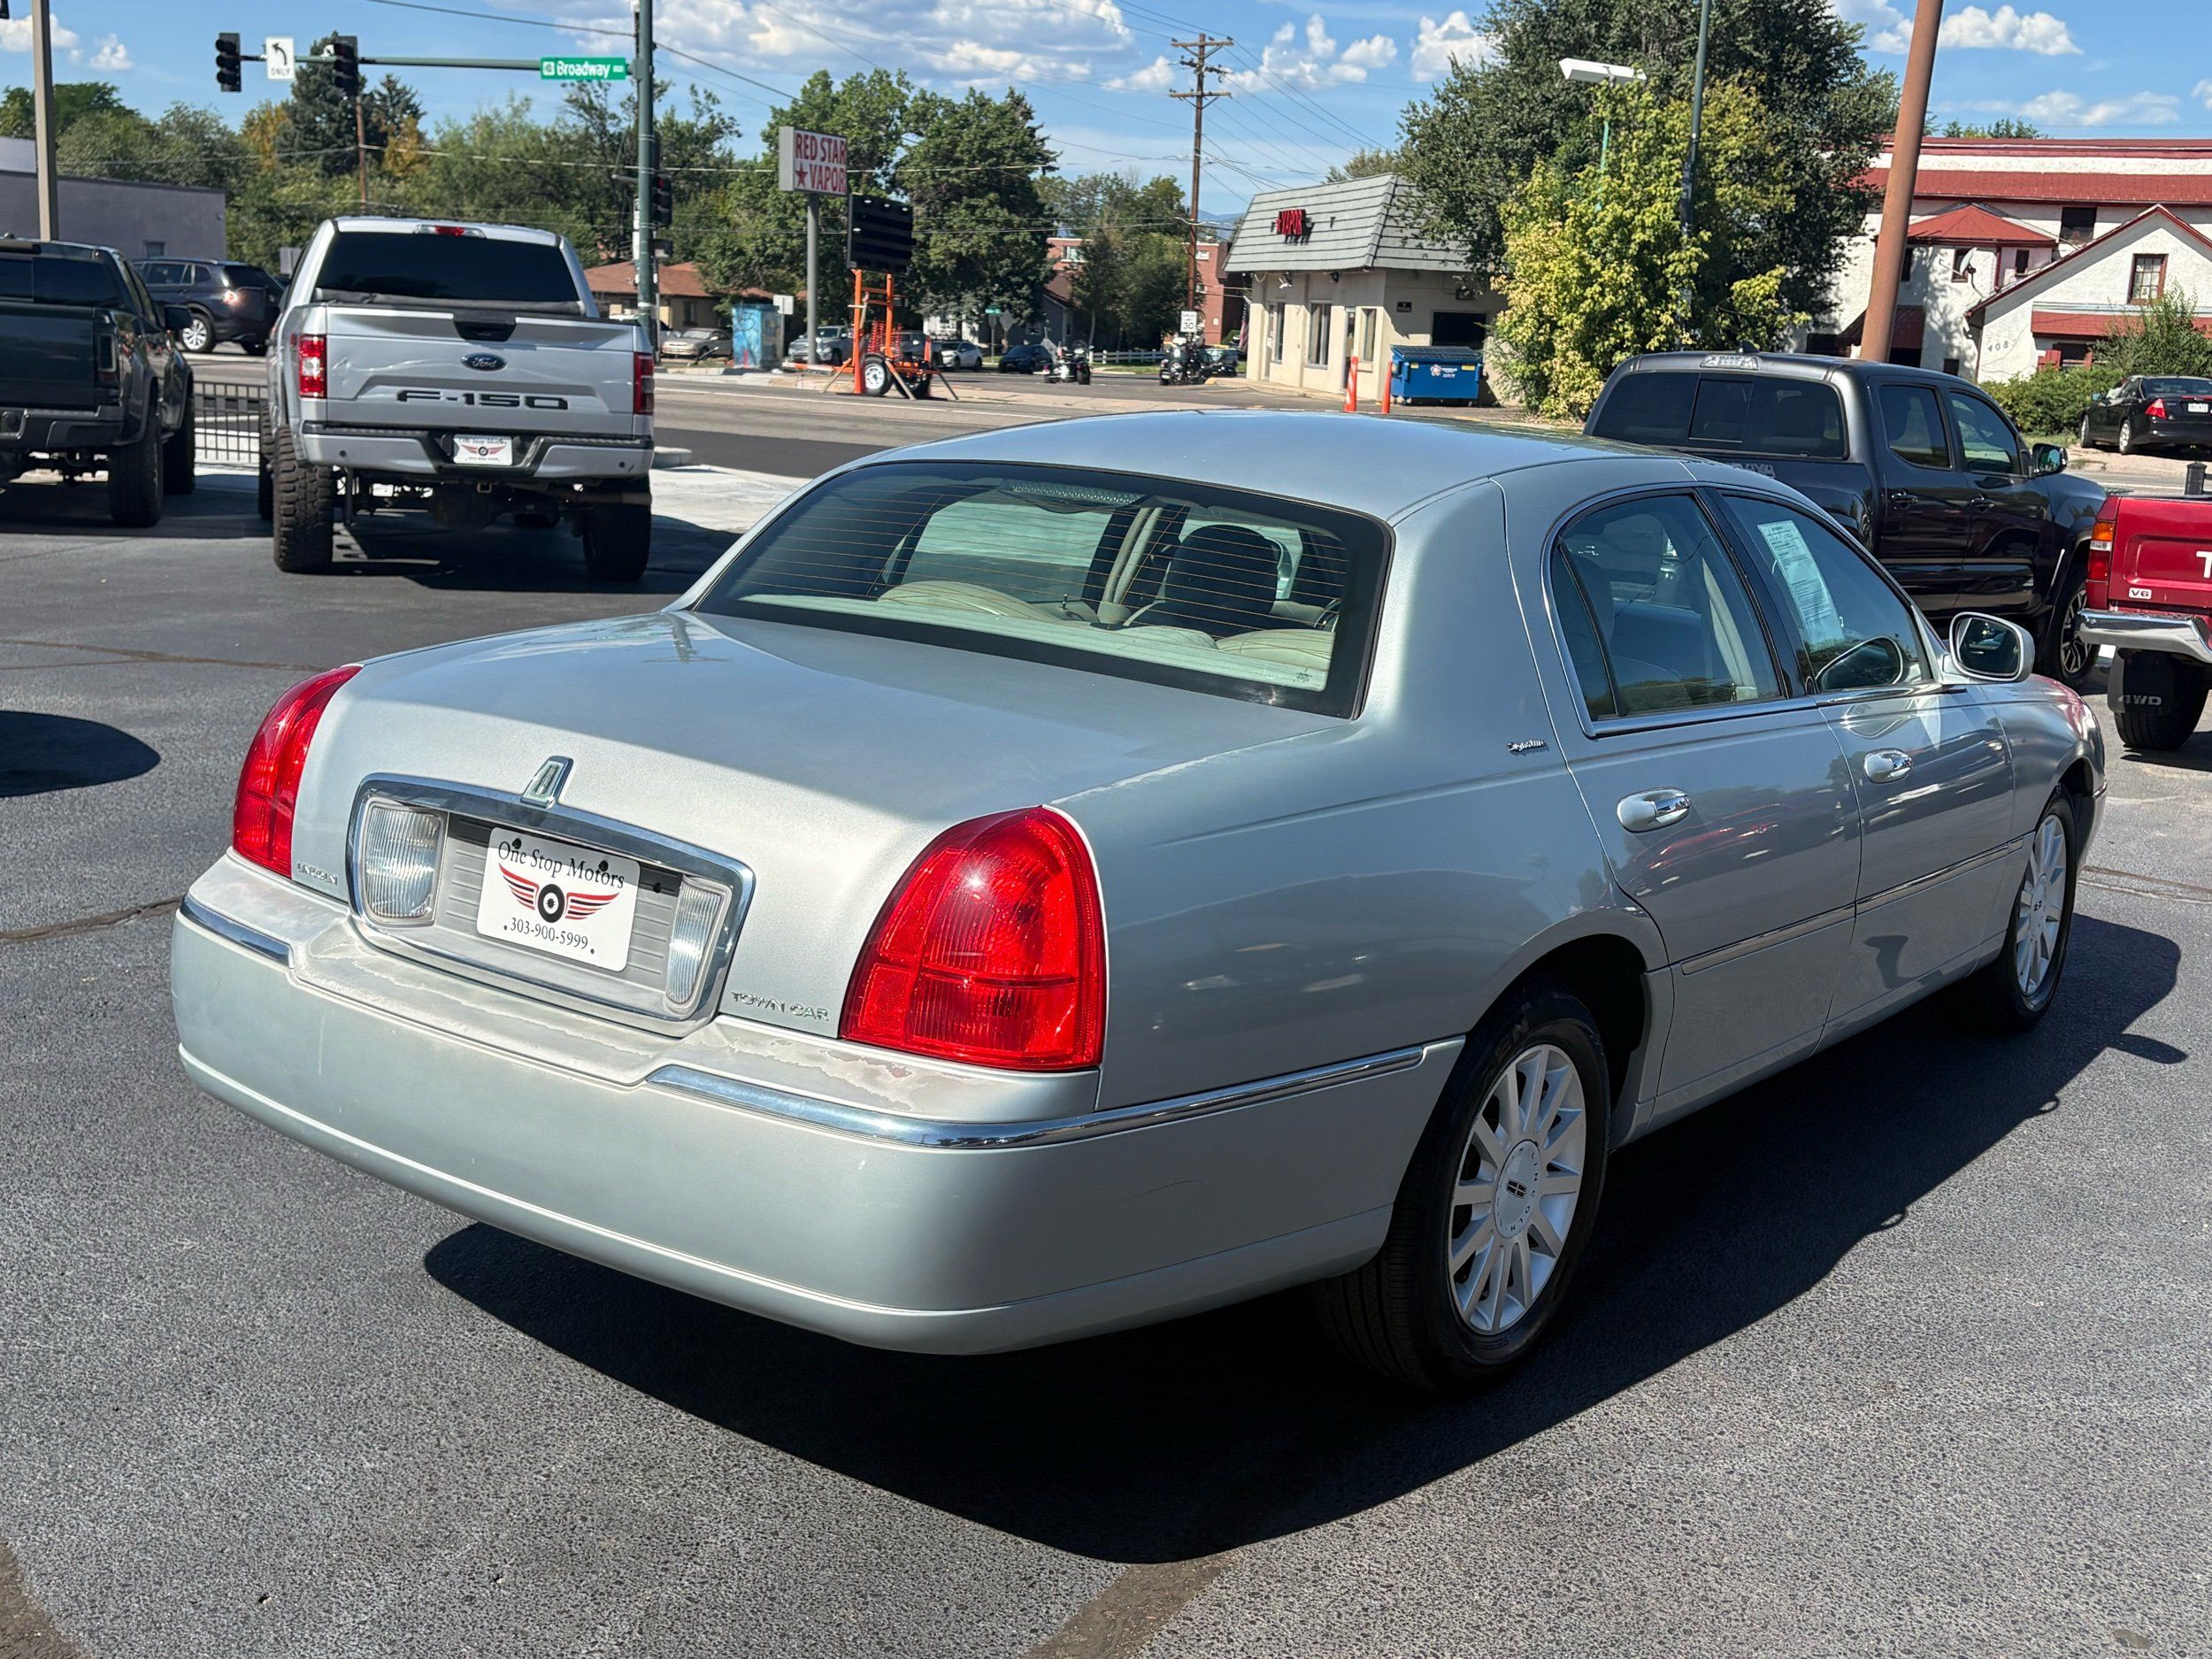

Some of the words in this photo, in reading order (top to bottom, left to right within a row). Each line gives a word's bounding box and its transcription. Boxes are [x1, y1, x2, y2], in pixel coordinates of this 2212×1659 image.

[557, 60, 611, 79] Broadway
[795, 132, 818, 160] RED
[819, 137, 847, 165] STAR
[810, 164, 847, 192] VAPOR
[472, 357, 497, 368] Ford
[397, 389, 568, 411] F-150
[2118, 695, 2162, 706] 4WD
[498, 841, 527, 864] One
[531, 849, 562, 878] Stop
[567, 858, 625, 889] Motors
[510, 917, 588, 950] 303-900-5999
[731, 991, 785, 1012] TOWN
[790, 1003, 829, 1021] CAR
